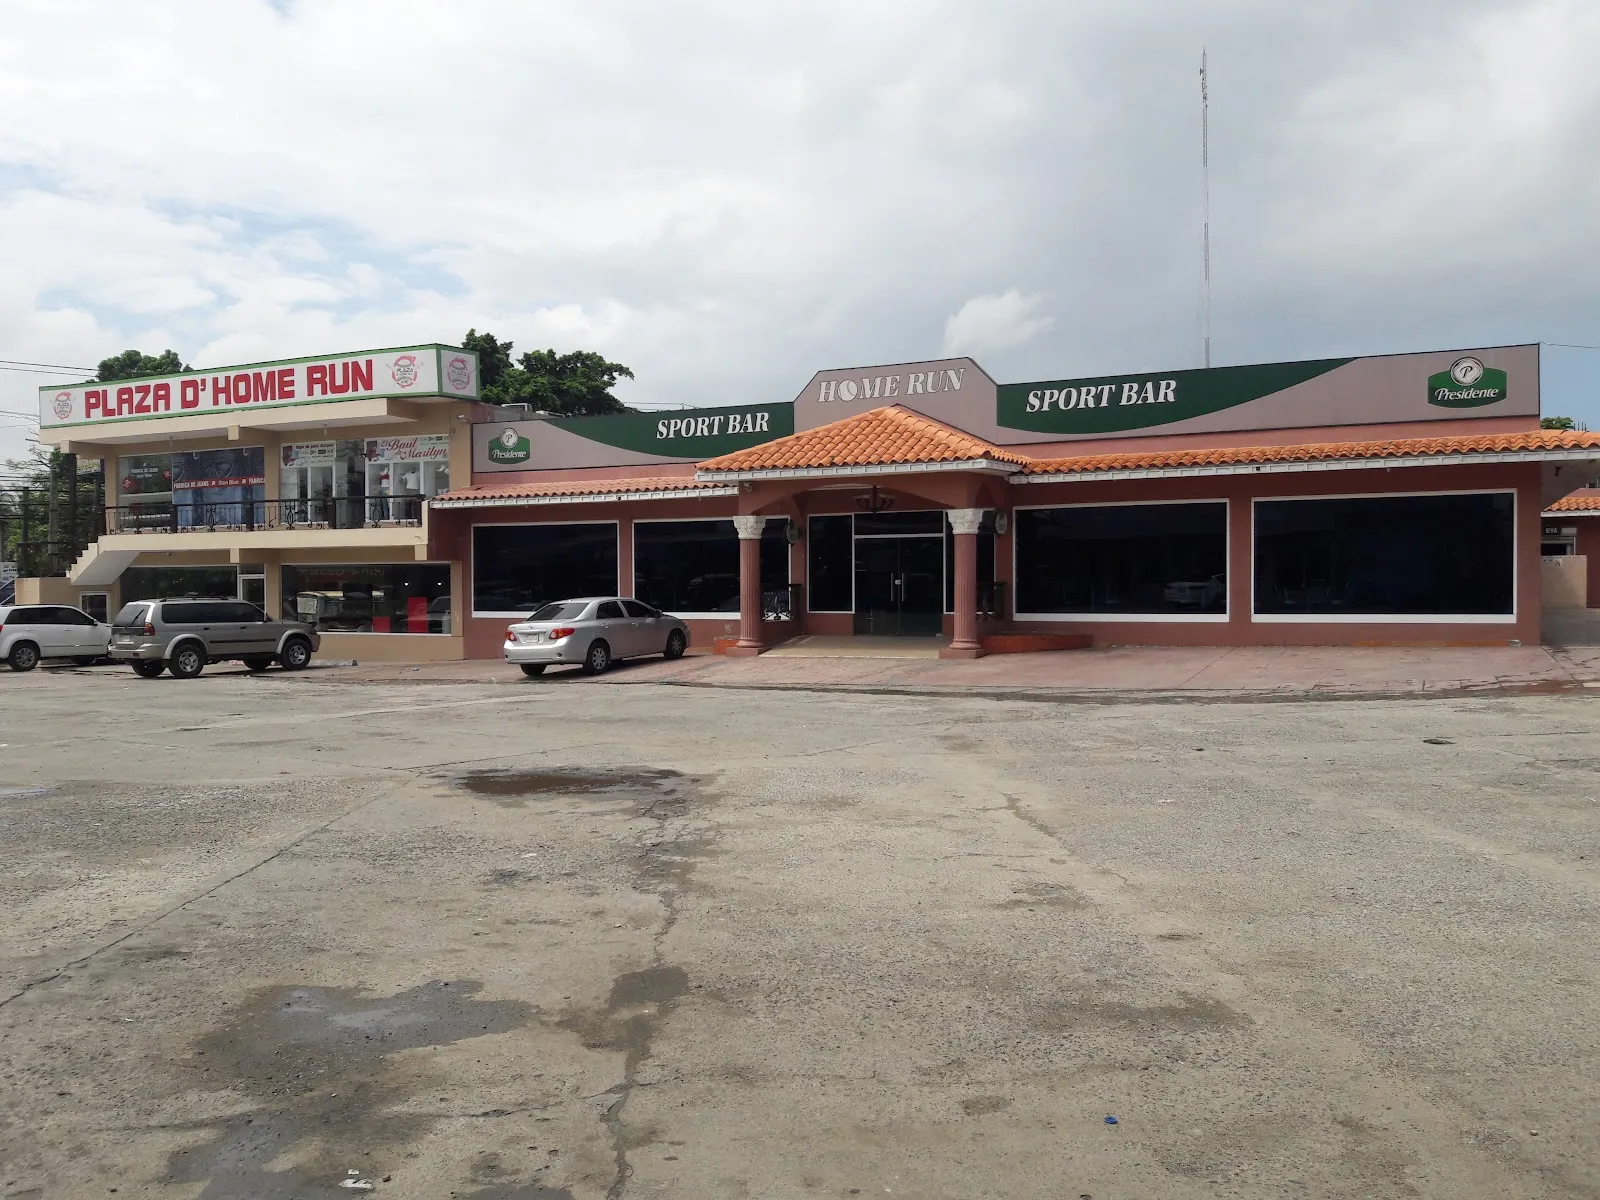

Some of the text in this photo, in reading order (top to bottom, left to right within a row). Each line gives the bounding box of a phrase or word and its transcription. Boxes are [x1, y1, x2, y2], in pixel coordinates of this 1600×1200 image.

[84, 382, 171, 418] PLAZA
[212, 368, 295, 406] HOME
[306, 359, 373, 397] RUN
[817, 368, 965, 402] HOME RUN
[1434, 387, 1499, 401] Presidente
[1025, 379, 1177, 413] SPORT BAR
[656, 412, 769, 439] SPORT BAR
[400, 446, 447, 460] Marilyn
[491, 449, 527, 459] Presidente
[173, 481, 190, 489] FABRICA
